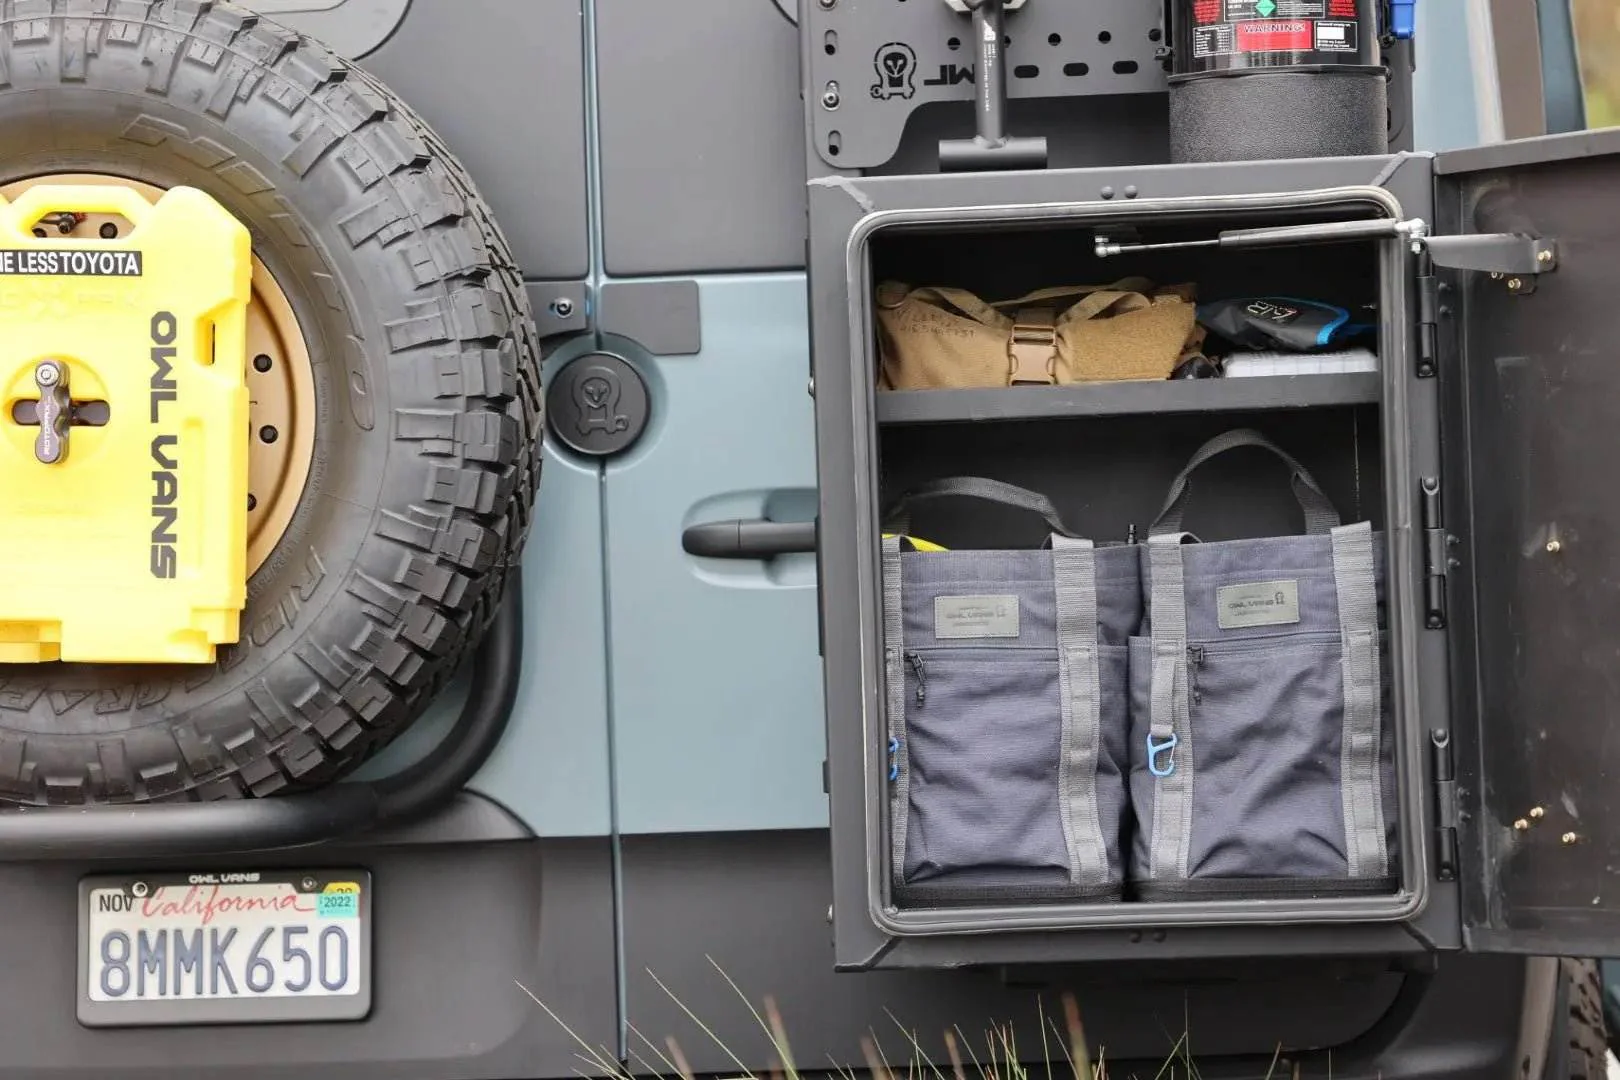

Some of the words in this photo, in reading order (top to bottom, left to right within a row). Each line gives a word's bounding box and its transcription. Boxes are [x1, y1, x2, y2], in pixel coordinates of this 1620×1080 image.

[0, 252, 14, 273] E
[18, 252, 58, 273] LESS
[60, 252, 139, 275] TOYOTA
[150, 311, 177, 423] OWL
[150, 435, 178, 579] VANS
[189, 874, 220, 884] OWL
[221, 872, 260, 883] VANS
[99, 894, 133, 912] NOV
[141, 884, 316, 925] California
[324, 895, 351, 908] 2022
[100, 925, 348, 997] 8MMK650
